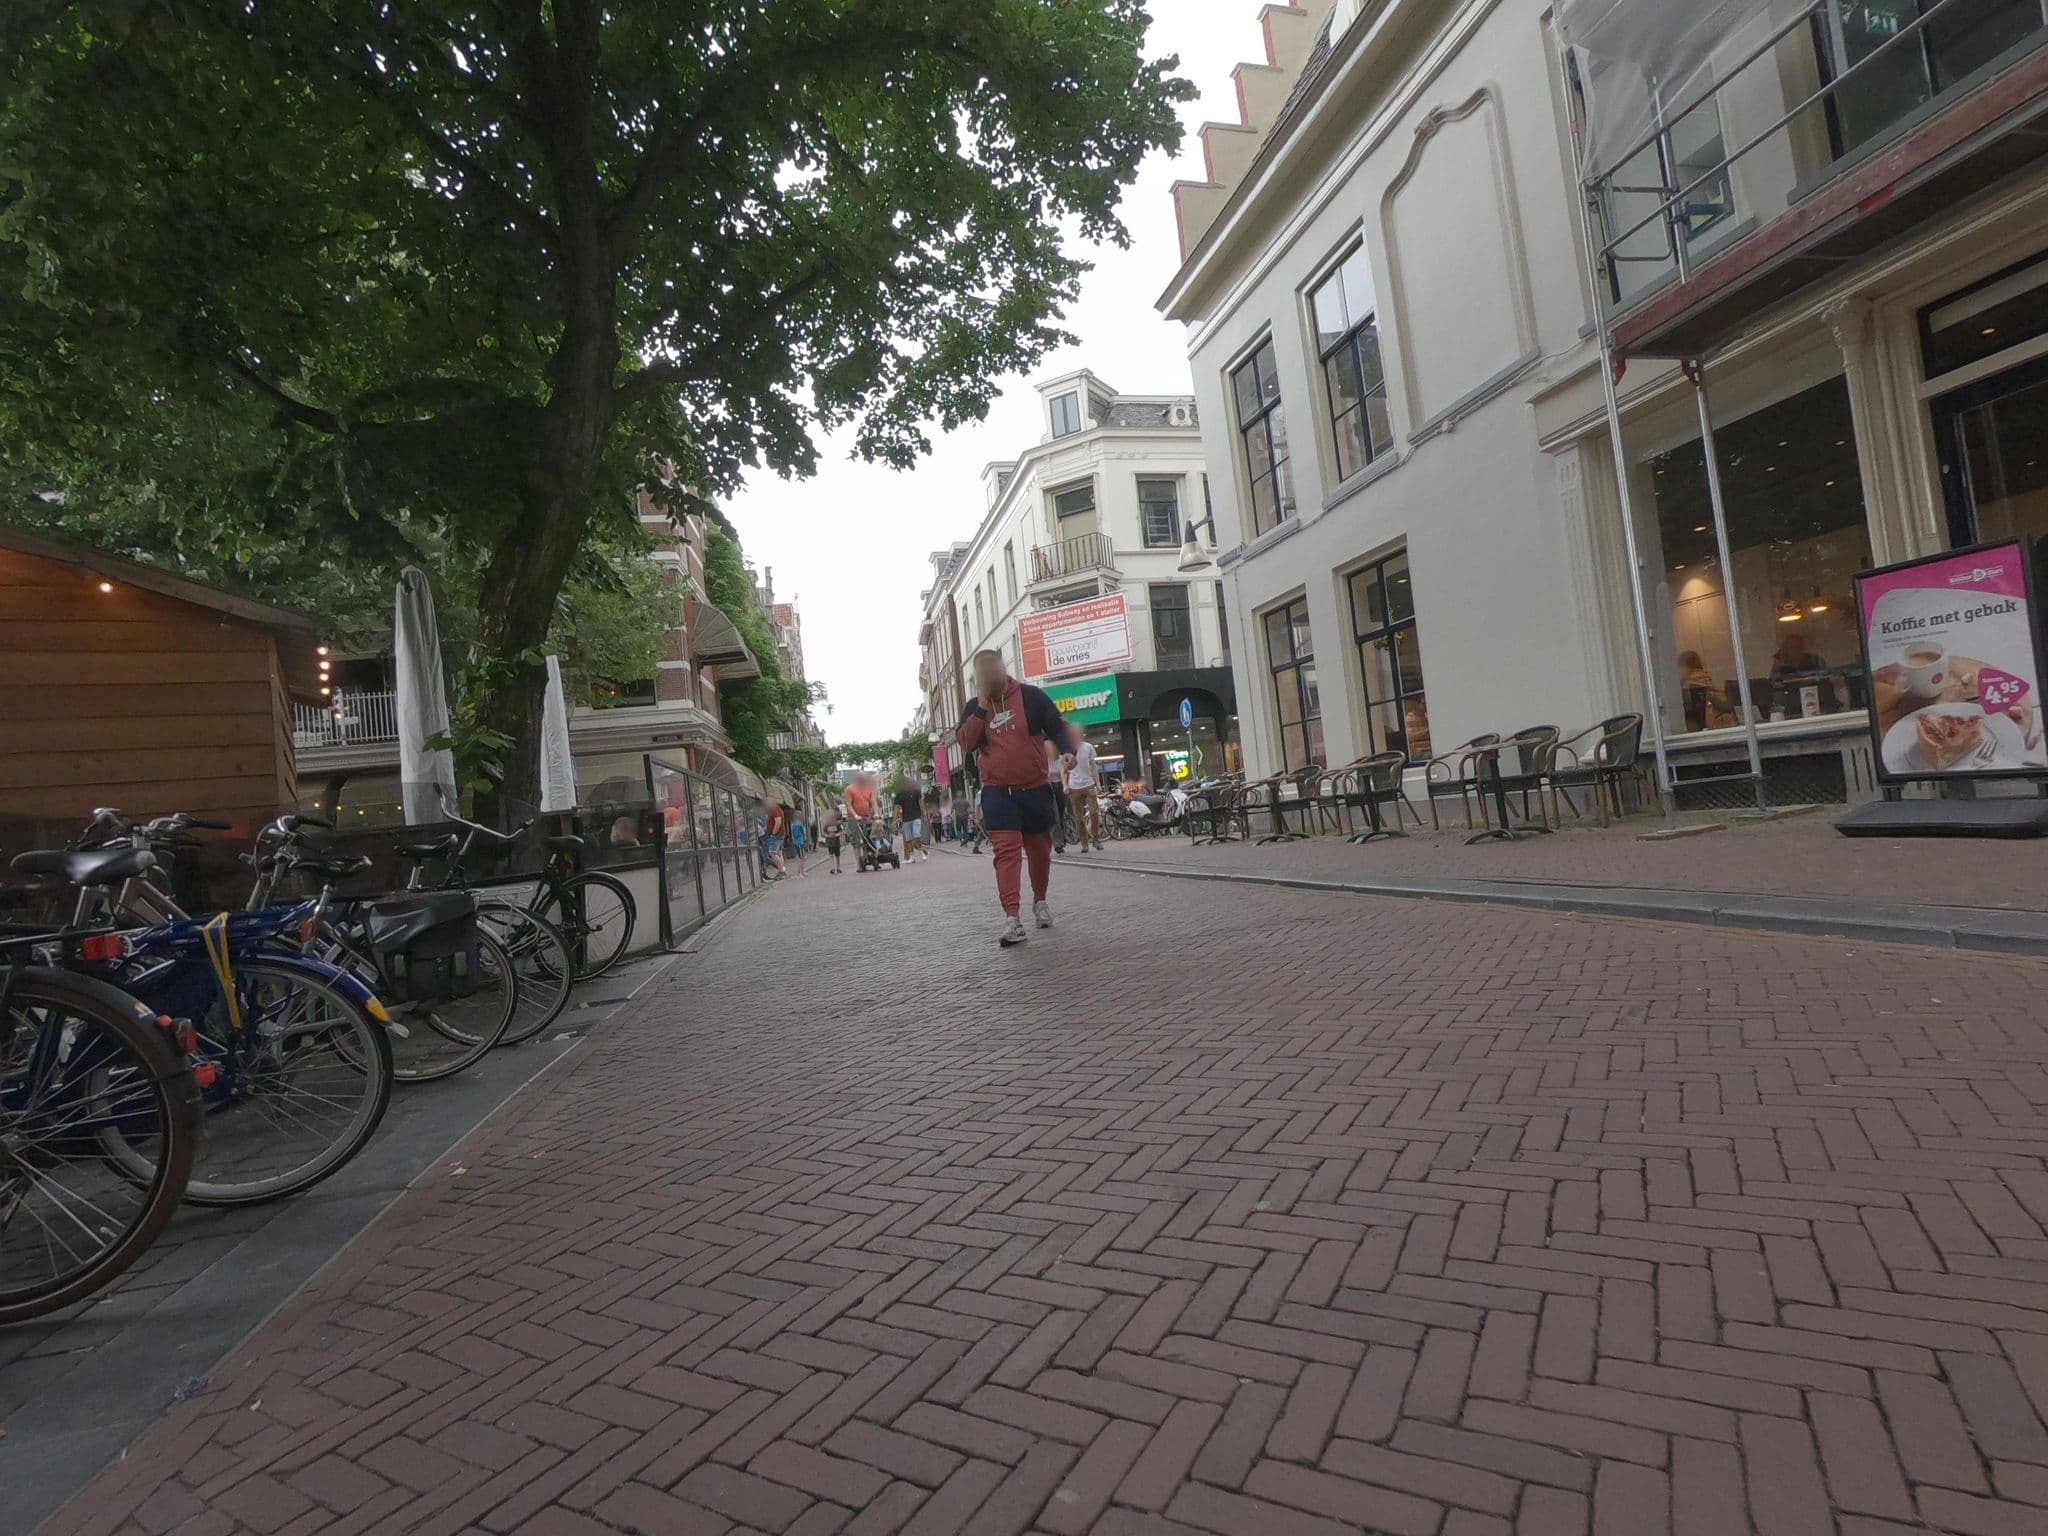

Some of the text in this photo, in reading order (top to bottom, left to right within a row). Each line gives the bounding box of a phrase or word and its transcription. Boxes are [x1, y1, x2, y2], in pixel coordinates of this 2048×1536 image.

[1056, 608, 1081, 620] Subway
[1880, 599, 2017, 634] Koffie met gebak
[1053, 651, 1091, 666] de vries
[1054, 689, 1113, 713] UBWAY
